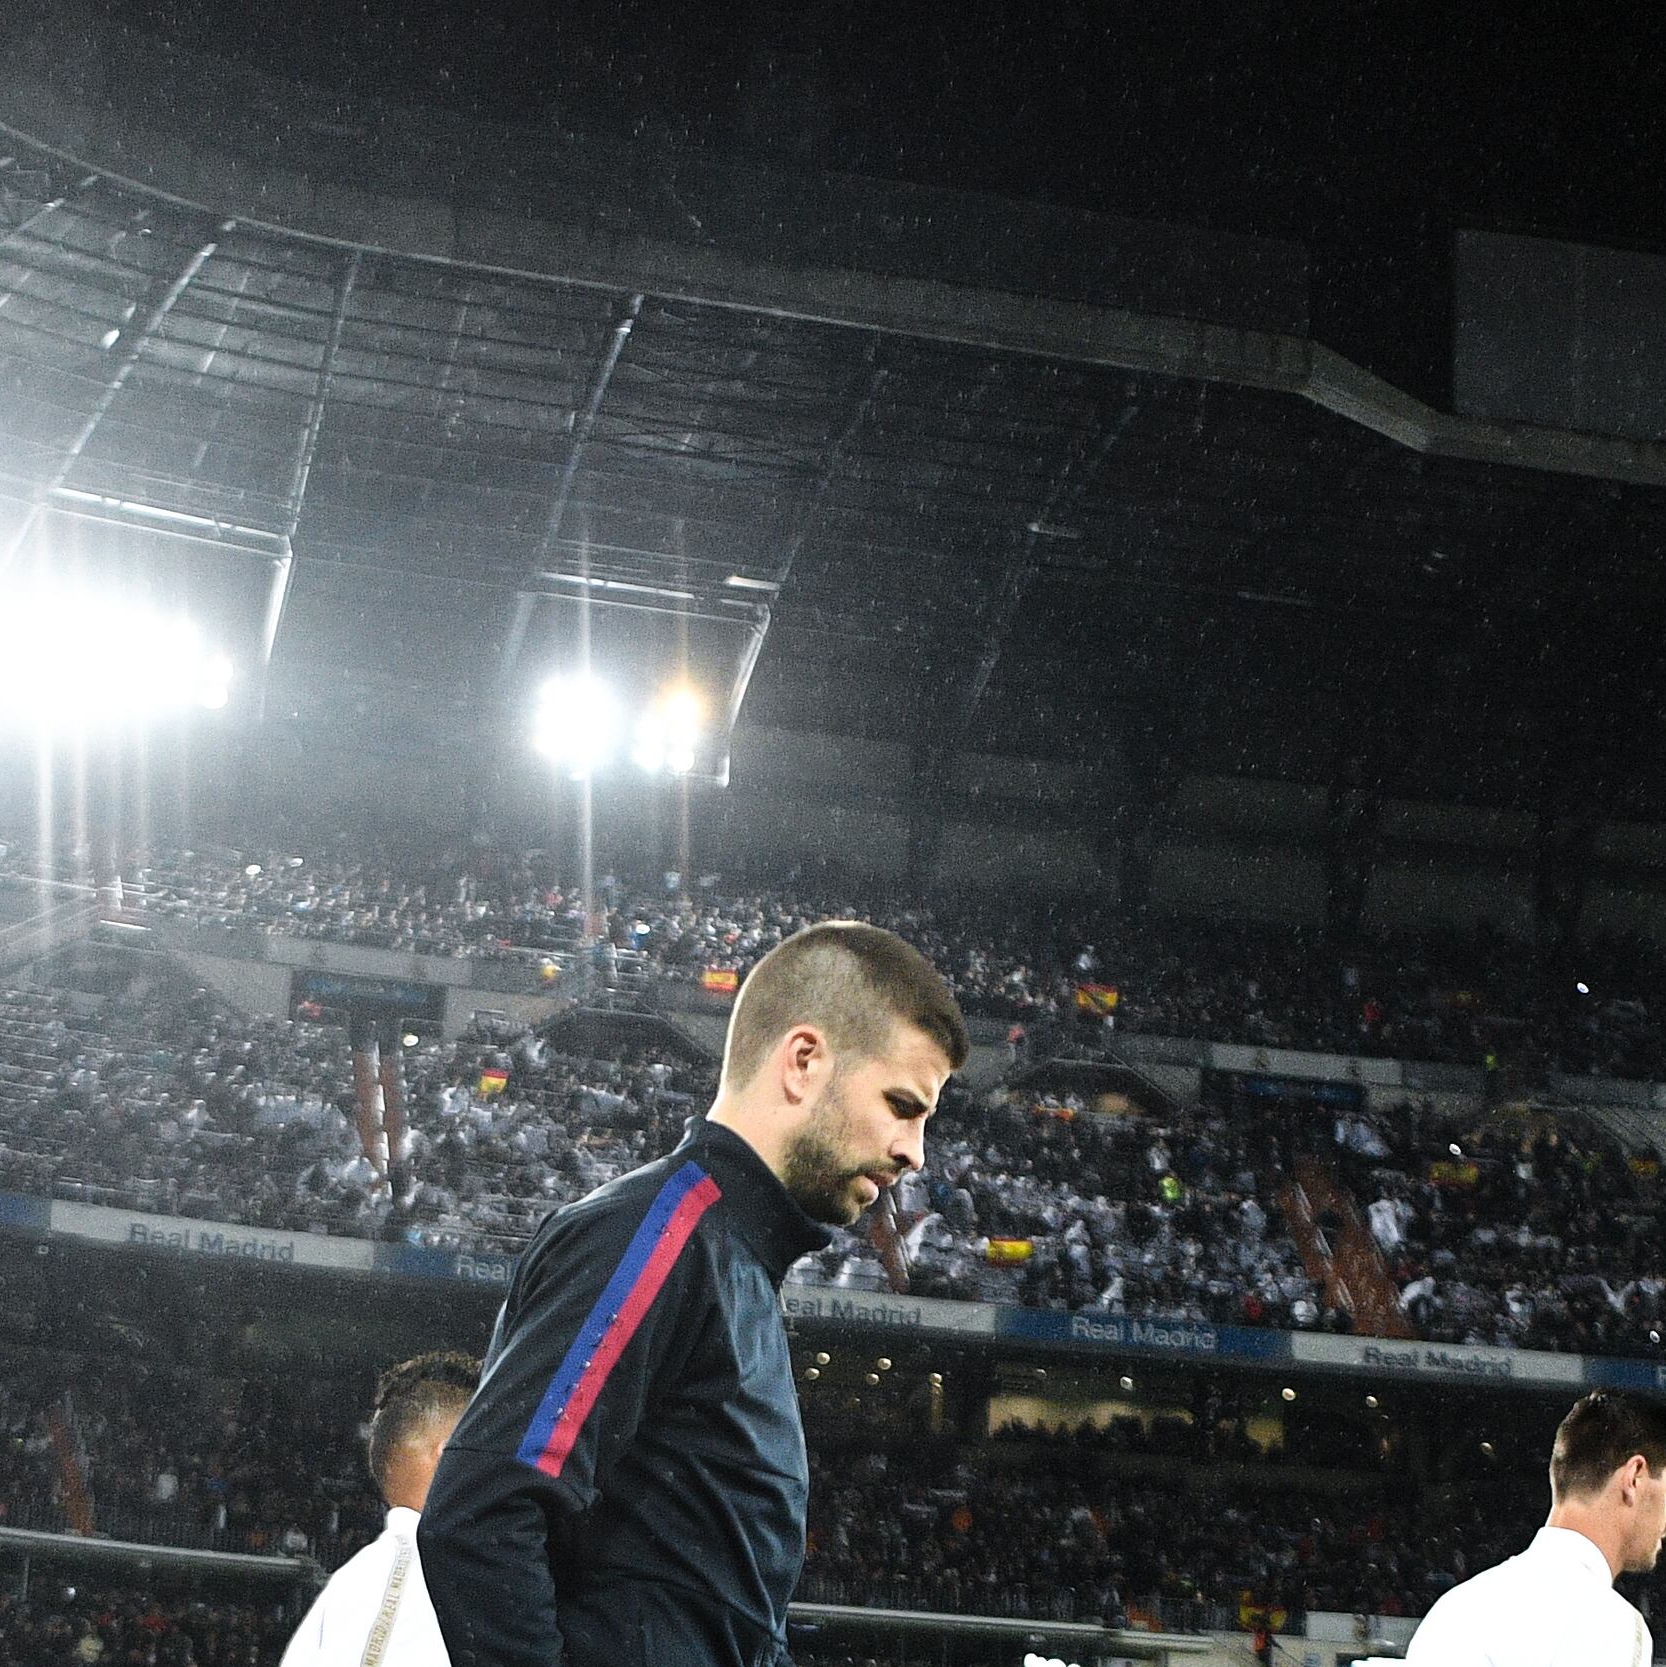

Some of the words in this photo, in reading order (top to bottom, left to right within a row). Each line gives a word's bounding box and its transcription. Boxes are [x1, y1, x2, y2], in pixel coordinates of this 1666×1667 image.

[128, 1223, 192, 1250] Real
[198, 1232, 296, 1263] Madrid
[786, 1297, 828, 1319] eal
[832, 1299, 921, 1327] Madrid
[1070, 1314, 1125, 1343] Real
[1129, 1321, 1217, 1351] Madrid
